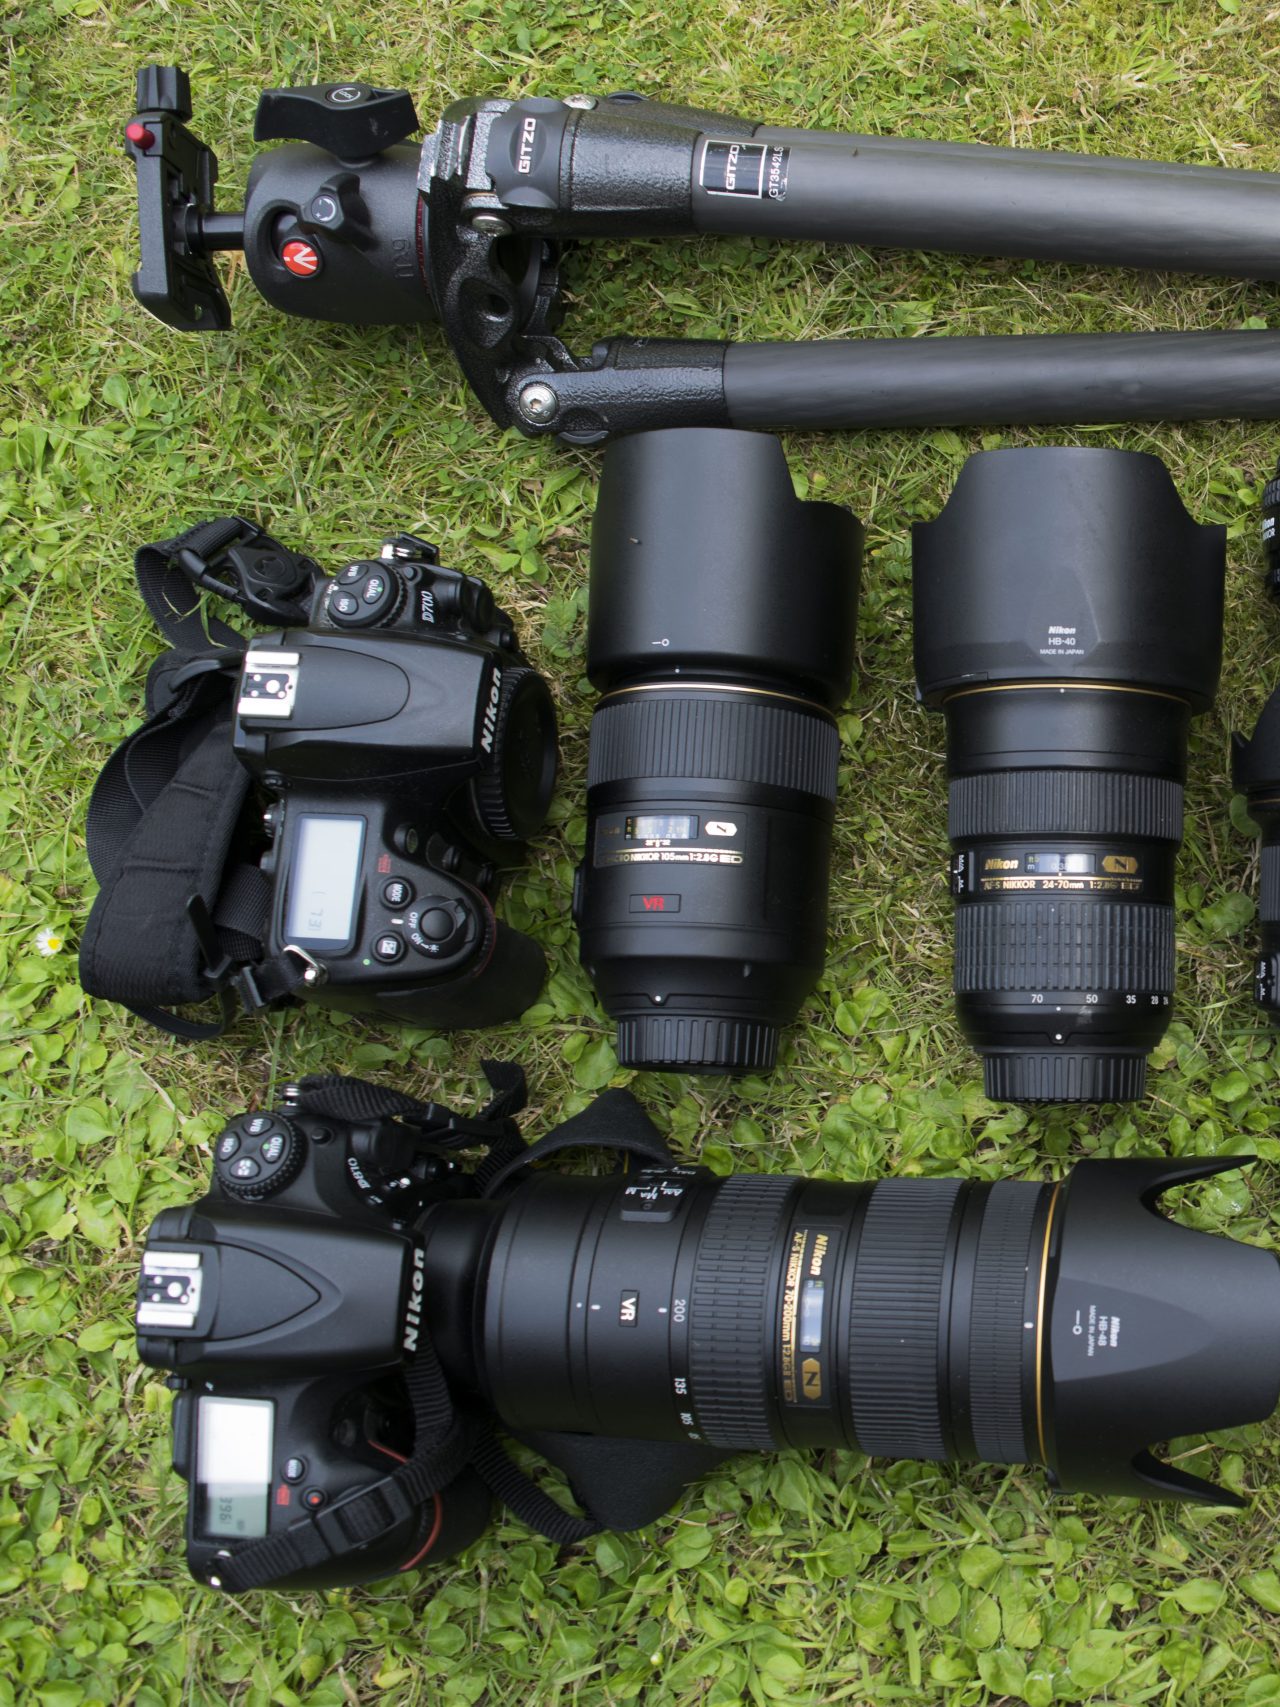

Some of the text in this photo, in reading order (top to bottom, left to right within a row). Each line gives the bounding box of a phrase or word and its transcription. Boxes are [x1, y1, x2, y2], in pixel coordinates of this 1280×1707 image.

[518, 118, 536, 173] GITZO
[725, 144, 740, 190] GITZO
[768, 146, 784, 198] GT3542LS
[347, 565, 360, 577] WB
[366, 579, 380, 599] QUAL
[339, 598, 350, 612] ISO
[421, 590, 435, 624] D700
[1048, 626, 1076, 634] Nikon
[1048, 637, 1076, 646] HB-40
[481, 667, 501, 754] Nikon
[661, 852, 689, 862] 105mm
[985, 858, 1019, 870] Nikon
[391, 883, 403, 902] MODE
[1003, 880, 1036, 889] NIKKOR
[1042, 880, 1084, 889] 24-70mm
[643, 896, 664, 911] VR
[408, 911, 419, 929] OFF
[1031, 994, 1044, 1004] 70
[1085, 994, 1099, 1004] 50
[1126, 994, 1137, 1004] 35
[250, 1118, 264, 1133] WB
[222, 1137, 234, 1153] ISO
[810, 1233, 828, 1276] Nikon
[785, 1253, 800, 1287] NIKKOR
[403, 1248, 424, 1352] Nikon
[620, 1297, 637, 1321] VR
[673, 1299, 686, 1323] 200
[781, 1289, 794, 1342] 70-200mm
[1110, 1316, 1120, 1348] Nikon
[674, 1377, 687, 1395] 135
